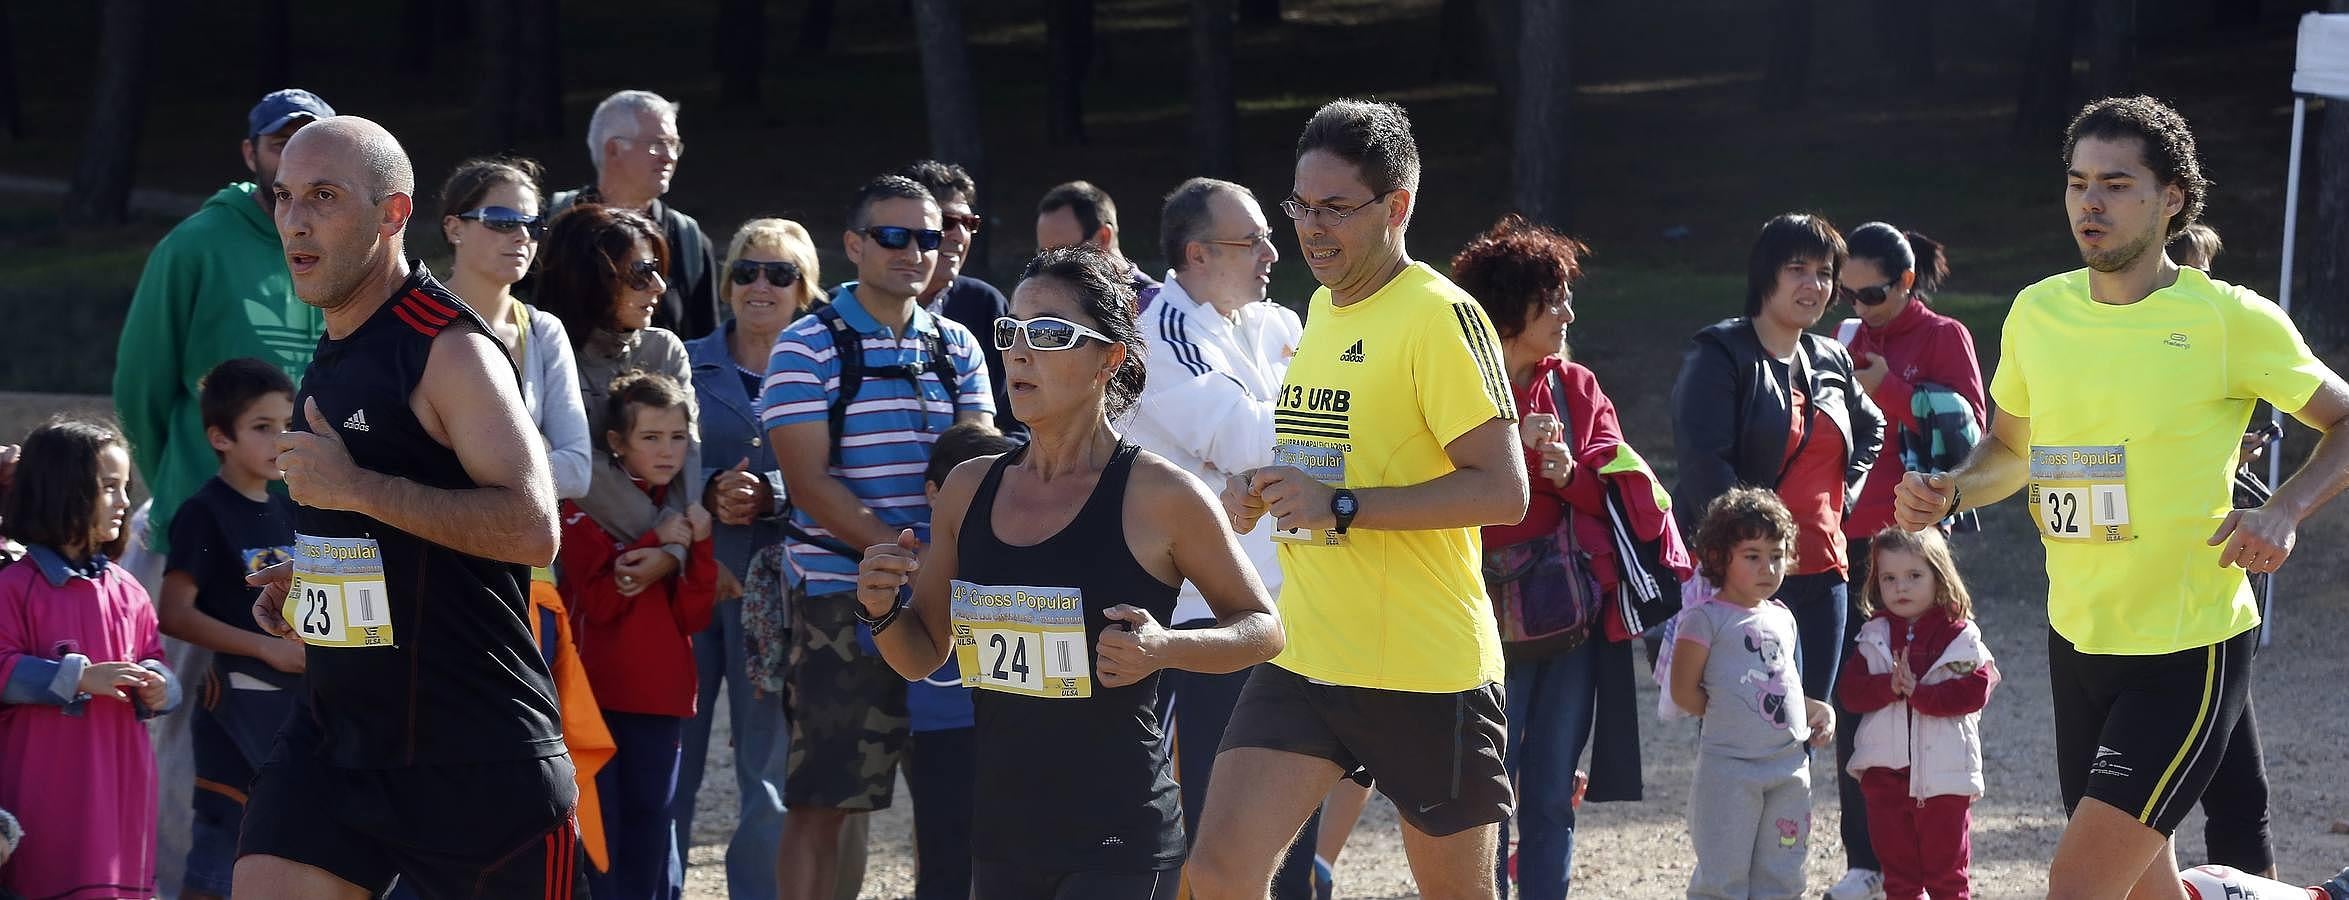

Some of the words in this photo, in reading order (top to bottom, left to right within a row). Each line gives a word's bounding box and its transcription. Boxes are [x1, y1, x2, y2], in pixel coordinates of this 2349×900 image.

[1339, 348, 1364, 363] adidas
[1308, 387, 1351, 413] URB
[343, 416, 370, 432] adidas
[1298, 449, 1342, 469] Popular
[2040, 450, 2068, 466] Cross
[2072, 450, 2123, 468] Popular
[2048, 492, 2079, 533] 32
[323, 542, 377, 562] Popular
[970, 589, 1012, 607] Cross
[1016, 591, 1080, 611] Popular
[303, 588, 331, 636] 23
[957, 638, 977, 646] ULSA
[989, 633, 1030, 684] 24
